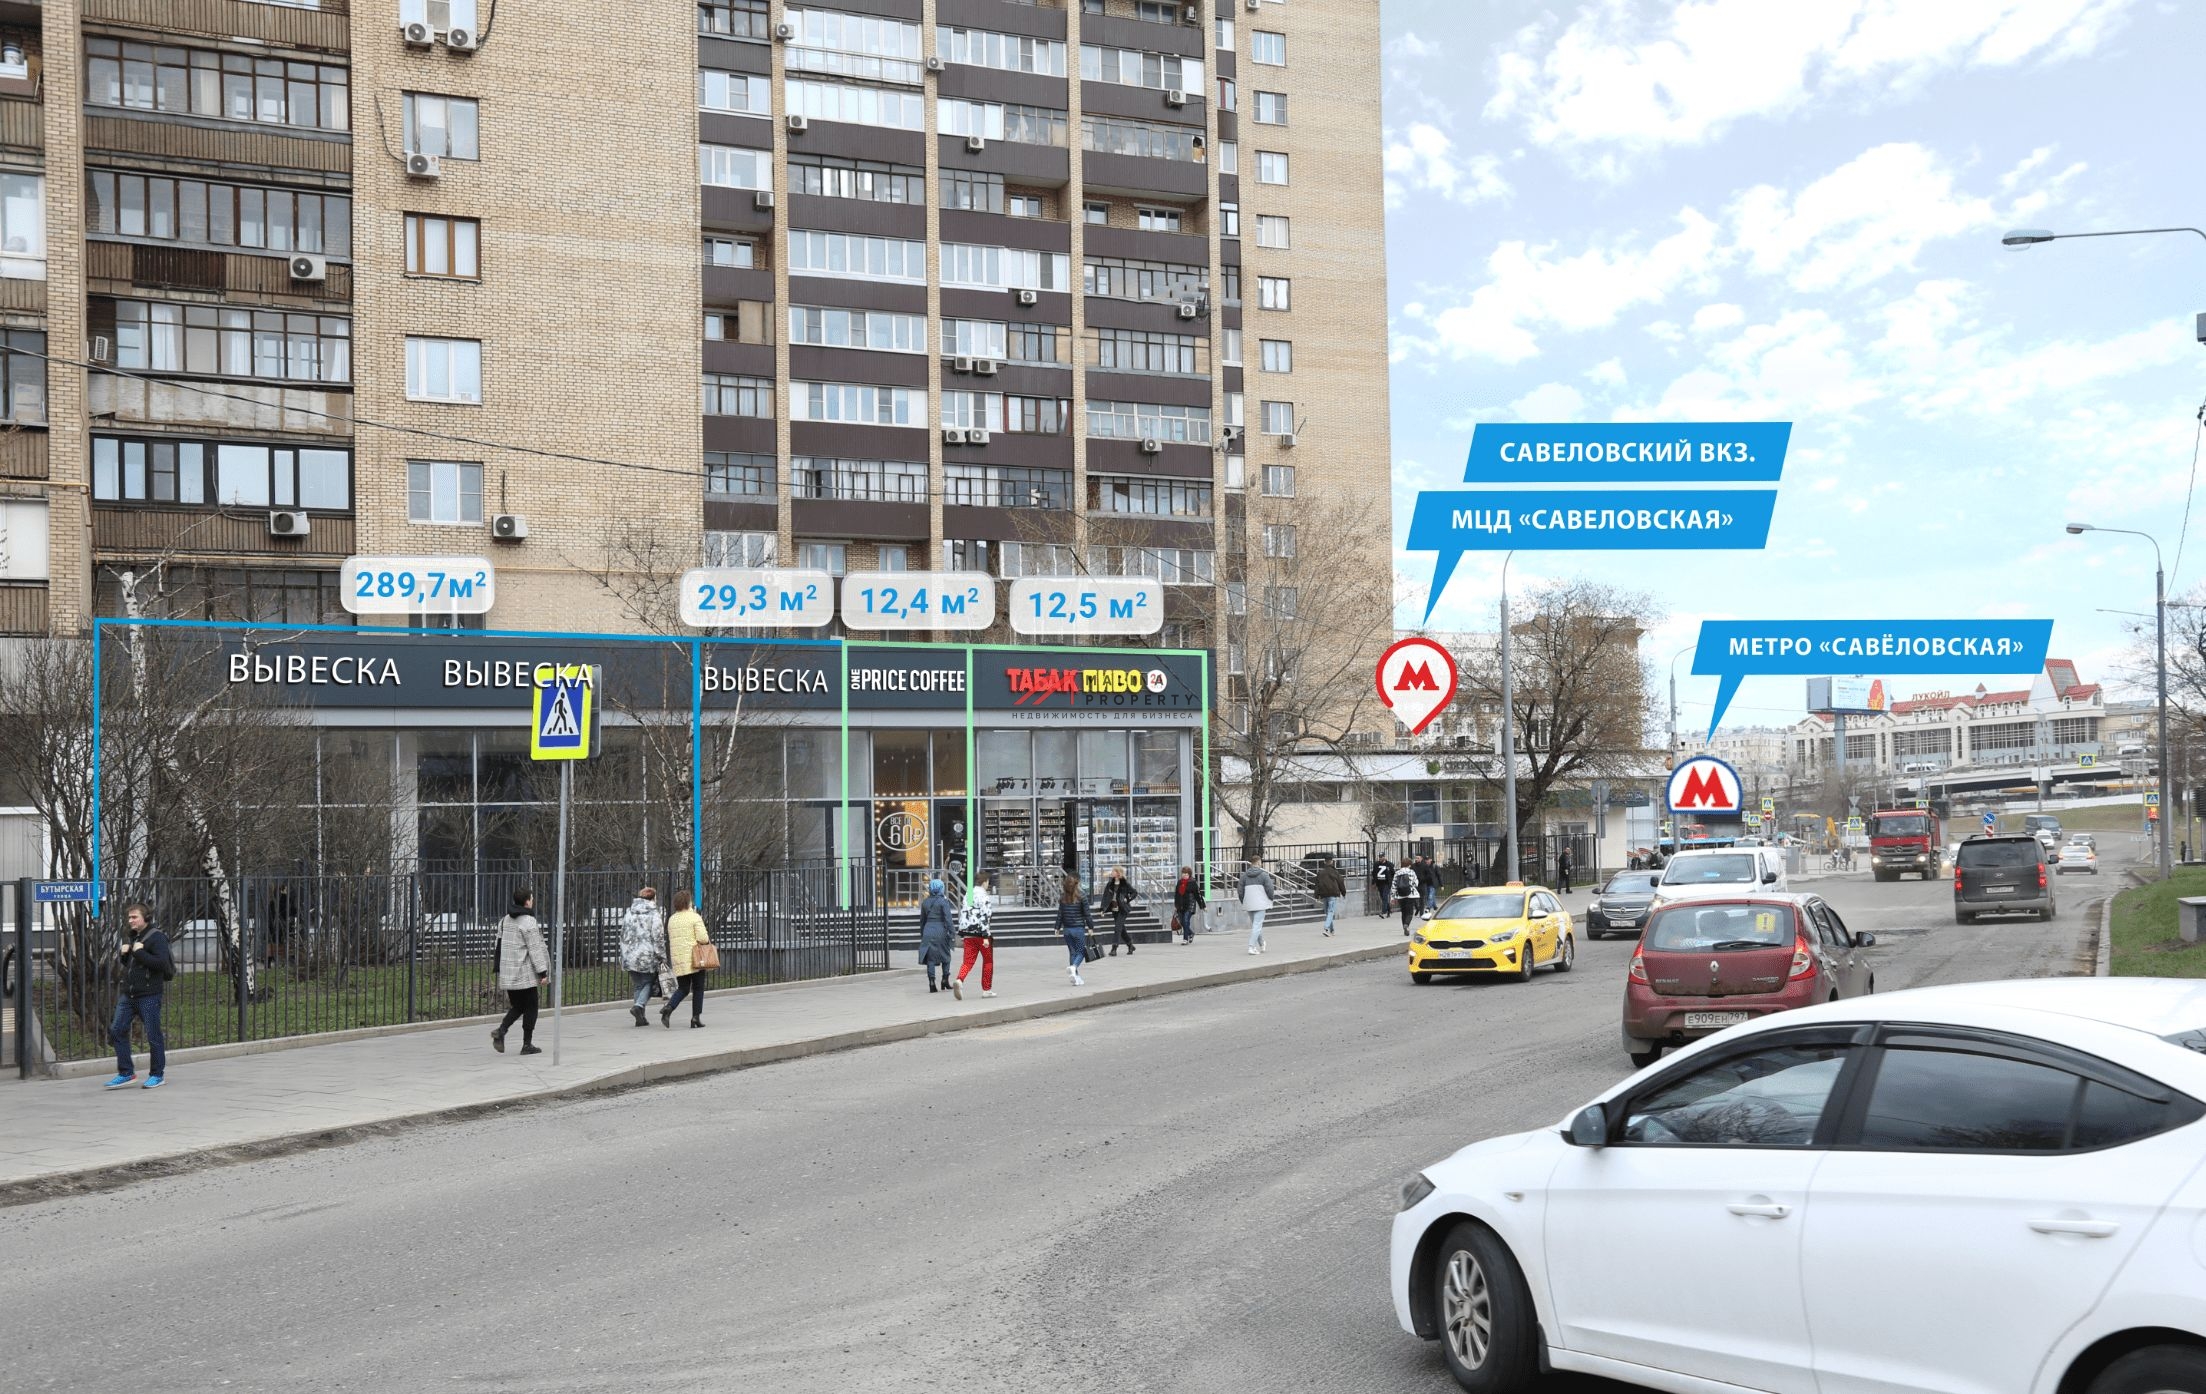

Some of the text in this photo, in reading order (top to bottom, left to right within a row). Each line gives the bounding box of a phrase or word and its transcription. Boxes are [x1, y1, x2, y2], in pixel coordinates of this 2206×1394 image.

[851, 669, 965, 692] ONE PRICE COFFEE
[1006, 668, 1079, 693] ТАБАК
[1082, 669, 1143, 693] ПИВО
[1912, 690, 1950, 701] ЛУКОЙЛ
[1377, 865, 1387, 878] Z
[40, 884, 84, 893] БУТЫРСКАЯ
